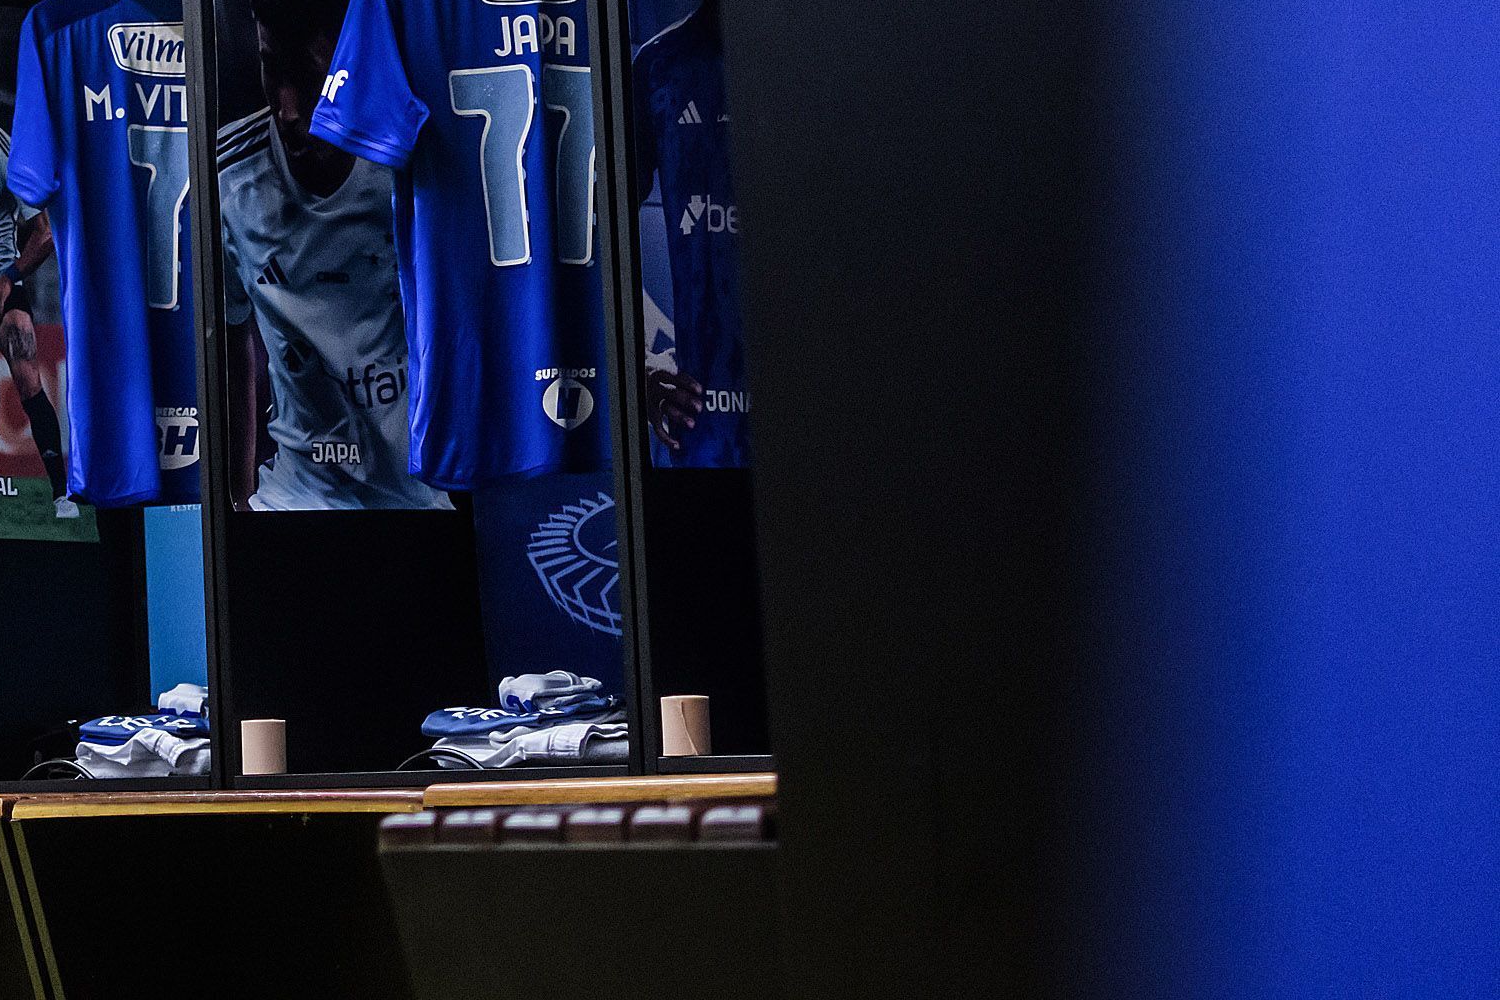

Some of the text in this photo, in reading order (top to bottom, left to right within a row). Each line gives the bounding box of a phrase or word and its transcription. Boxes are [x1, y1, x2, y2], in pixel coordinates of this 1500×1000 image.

[116, 30, 185, 64] Vilm
[494, 14, 576, 56] JAPA
[83, 83, 125, 122] M.
[312, 441, 361, 465] JAPA
